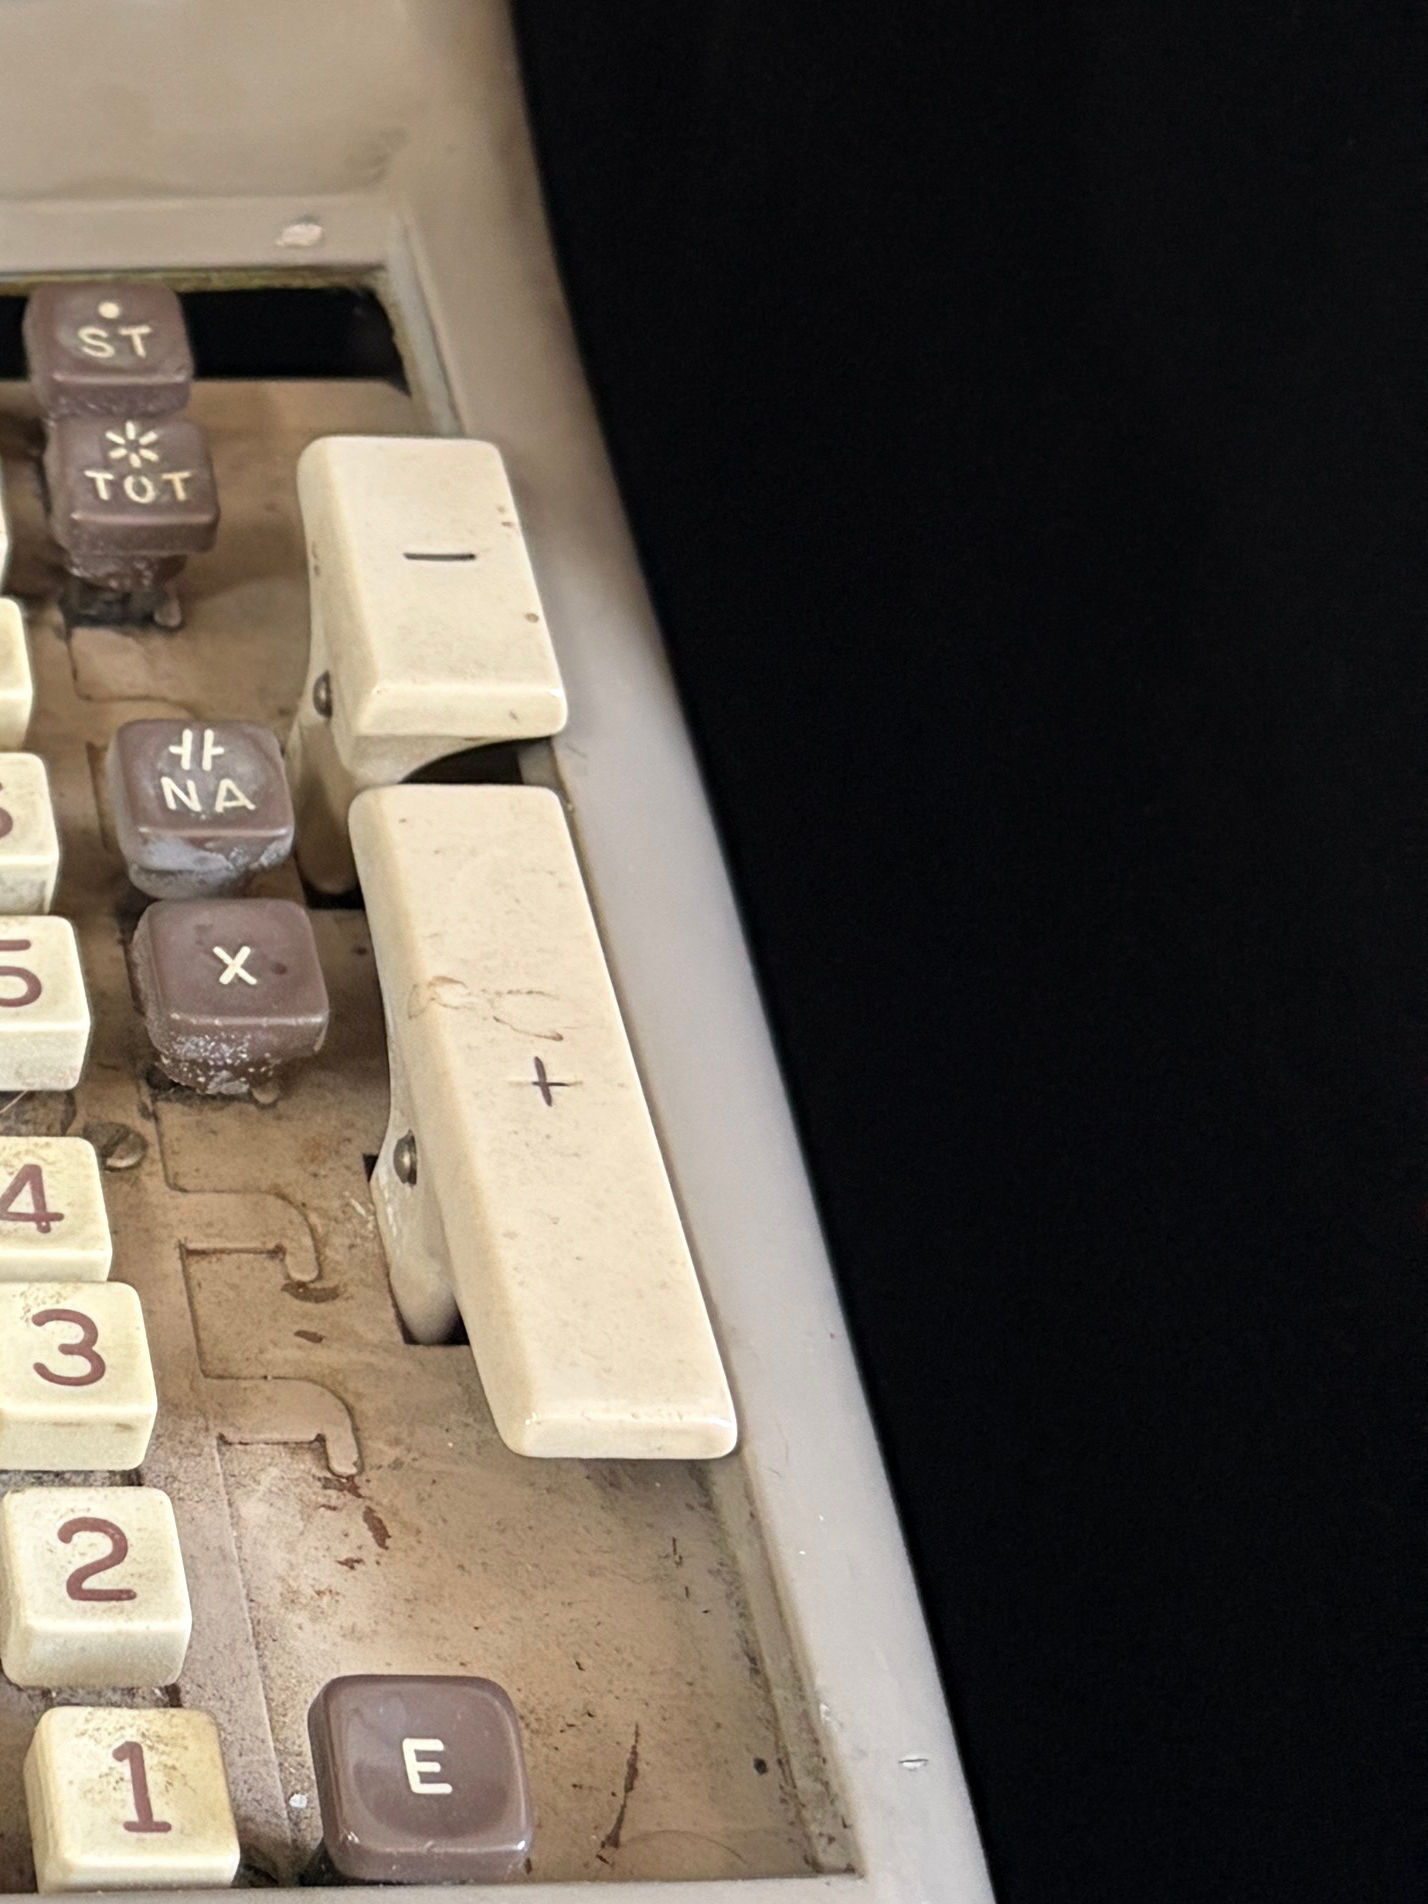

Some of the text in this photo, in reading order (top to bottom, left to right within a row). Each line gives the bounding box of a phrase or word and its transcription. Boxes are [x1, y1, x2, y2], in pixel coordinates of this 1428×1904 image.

[77, 325, 152, 360] ST
[84, 470, 196, 503] TOT
[162, 778, 256, 815] NA
[31, 1308, 107, 1388] 3
[57, 1517, 138, 1603] 2
[112, 1741, 173, 1834] 1
[402, 1737, 453, 1795] E
